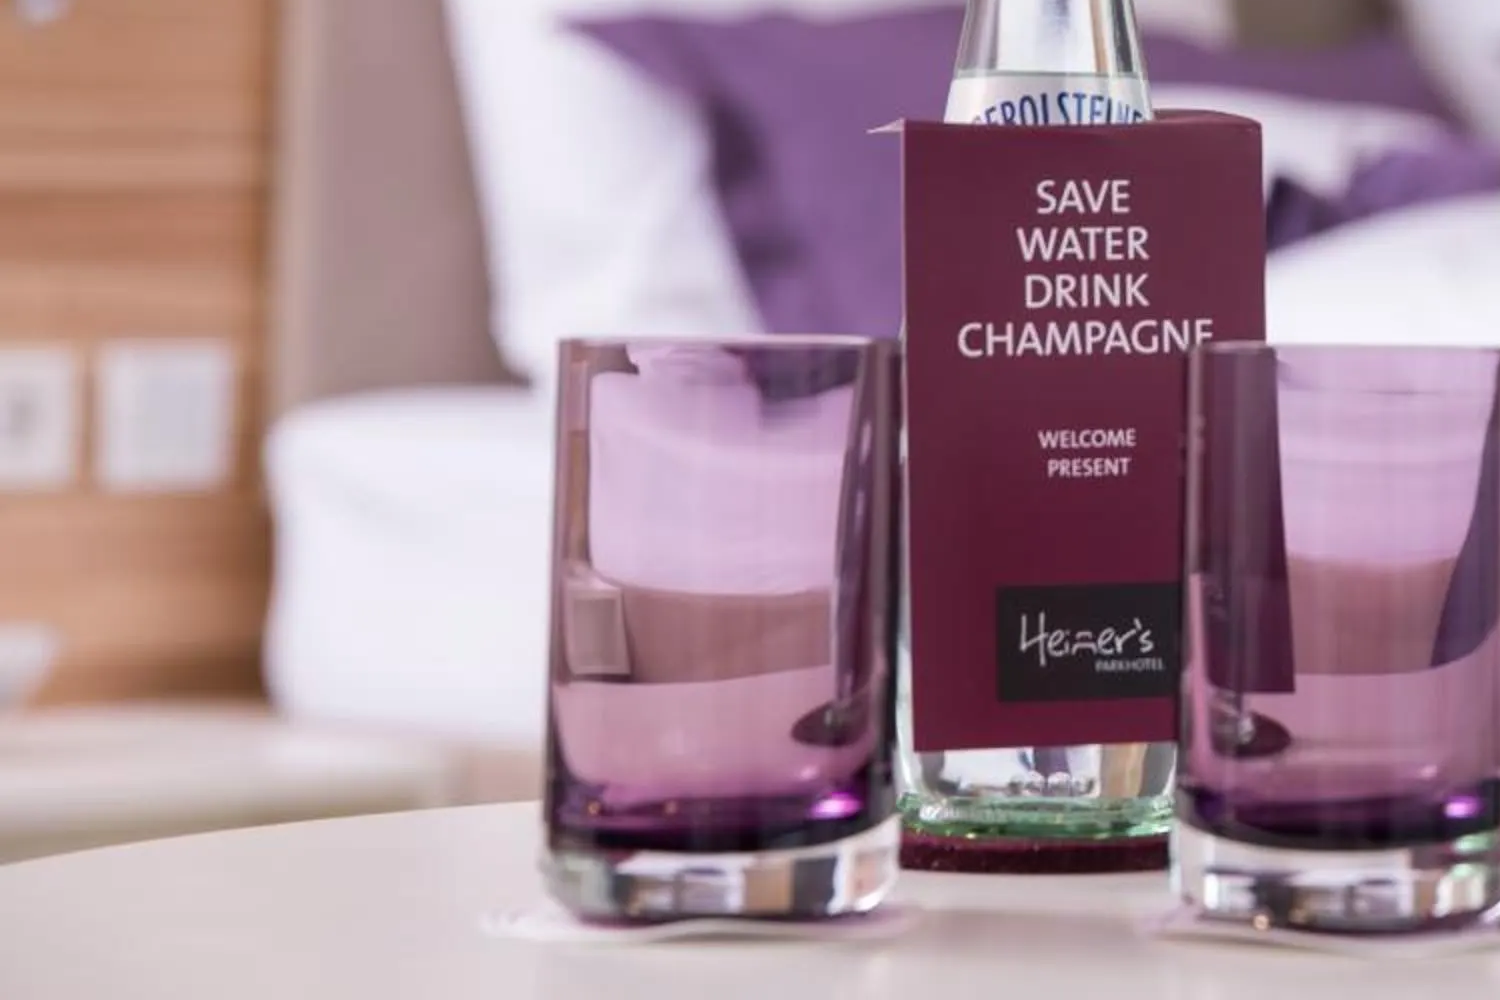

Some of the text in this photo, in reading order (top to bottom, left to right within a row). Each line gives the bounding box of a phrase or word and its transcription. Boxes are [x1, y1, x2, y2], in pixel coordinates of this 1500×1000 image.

[1036, 179, 1131, 214] SAVE
[1016, 226, 1150, 262] WATER
[1025, 273, 1150, 309] DRINK
[1037, 428, 1137, 449] WELCOME
[1047, 457, 1132, 477] PRESENT
[1019, 611, 1154, 667] Heiner's
[1095, 657, 1164, 672] PARKHOTEL
